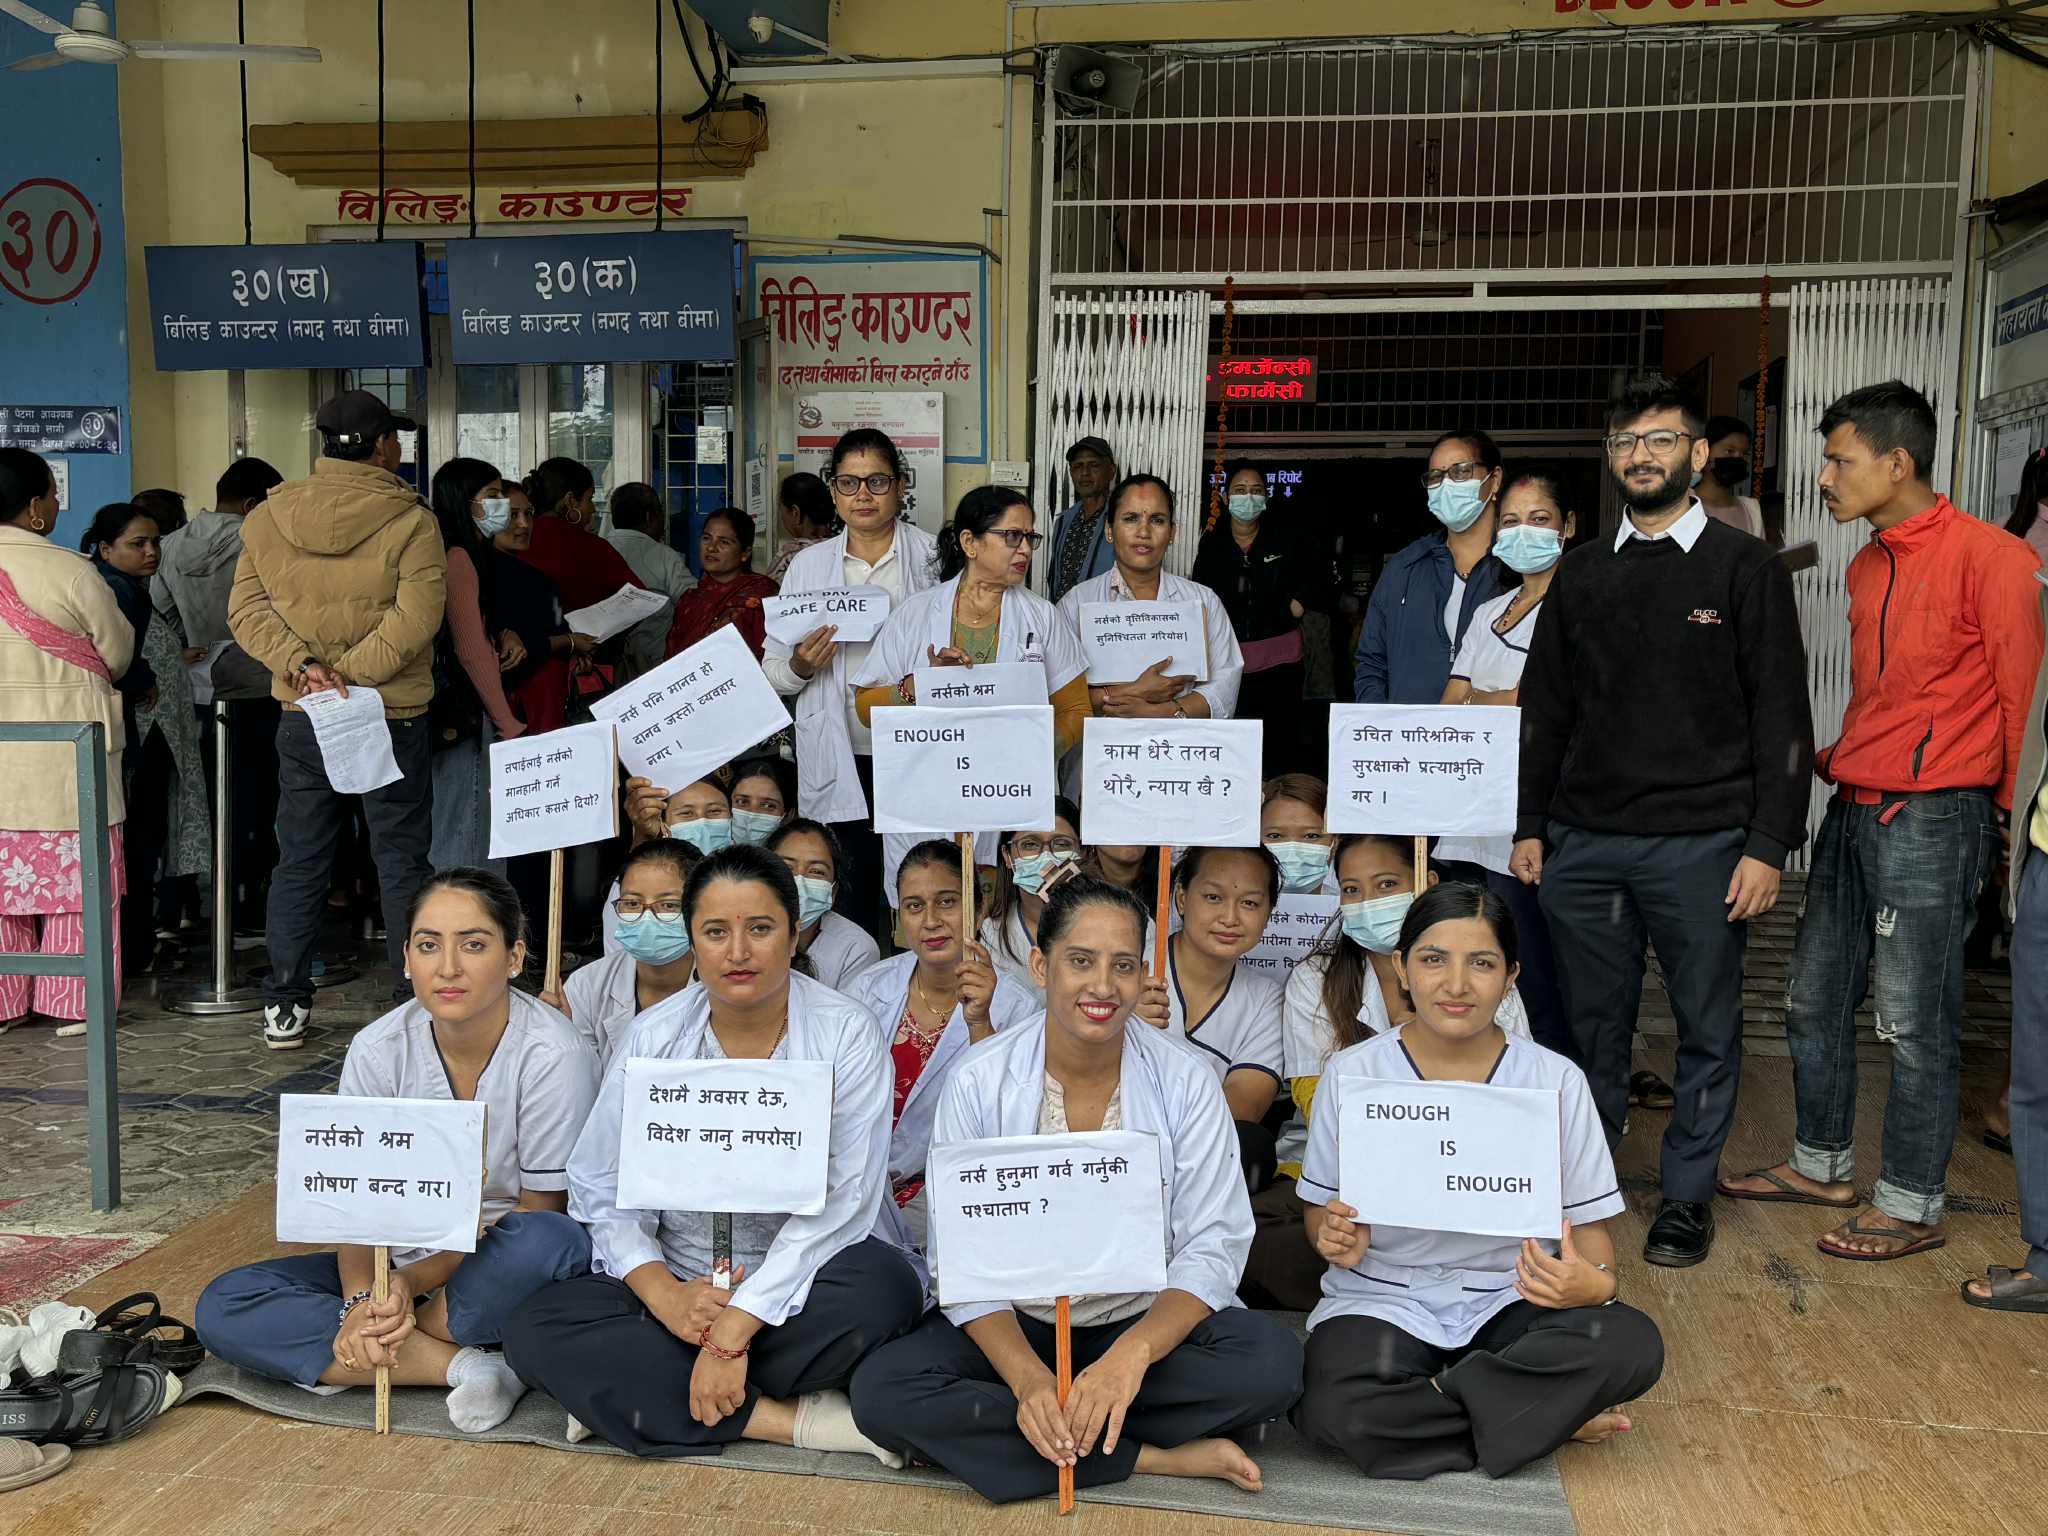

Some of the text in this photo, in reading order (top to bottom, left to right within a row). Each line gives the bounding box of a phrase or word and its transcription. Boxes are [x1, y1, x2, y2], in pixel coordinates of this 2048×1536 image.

[500, 188, 692, 219] काउण्टर
[2, 209, 79, 288] ३०
[231, 264, 329, 307] ३०(ख)
[534, 255, 637, 300] ३०(क)
[592, 311, 631, 334] (नगद
[638, 311, 669, 330] तथा
[852, 291, 972, 346] काउण्टर
[287, 319, 326, 342] (नगद
[332, 319, 362, 337] तथा
[780, 599, 867, 618] SAFE CARE
[618, 661, 715, 724] नर्स पनि मानव हो
[931, 682, 996, 699] नर्सको श्रम
[632, 678, 738, 746] दानव जस्तो व्यवहार
[894, 728, 965, 743] ENOUGH
[1352, 725, 1493, 745] उचित पारिश्रमिक र
[546, 746, 573, 763] नर्सको
[646, 745, 673, 766] नगर
[1103, 739, 1223, 762] काम धेरै तलब
[956, 756, 970, 770] IS
[1352, 757, 1485, 780] सुरक्षाको प्रत्याभुति
[505, 779, 541, 798] मानहानी
[961, 784, 1032, 798] ENOUGH
[1103, 773, 1142, 799] थोरै,
[1148, 779, 1192, 796] न्याय
[1197, 775, 1215, 796] खै
[1351, 790, 1373, 803] गर
[505, 806, 541, 823] अधिकार
[544, 798, 570, 815] कसले
[649, 1083, 690, 1104] देशमै
[698, 1088, 749, 1105] अवसर
[1366, 1103, 1450, 1121] ENOUGH
[305, 1123, 414, 1149] नर्सको श्रम
[647, 1122, 691, 1143] विदेश
[699, 1128, 734, 1151] जानु
[1440, 1140, 1457, 1156] IS
[304, 1171, 358, 1193] शोषण
[368, 1177, 408, 1197] बन्द
[960, 1156, 1129, 1191] नर्स हुनुमा गर्व गर्नुकी
[1446, 1175, 1532, 1193] ENOUGH
[962, 1200, 1031, 1218] पश्चाताप
